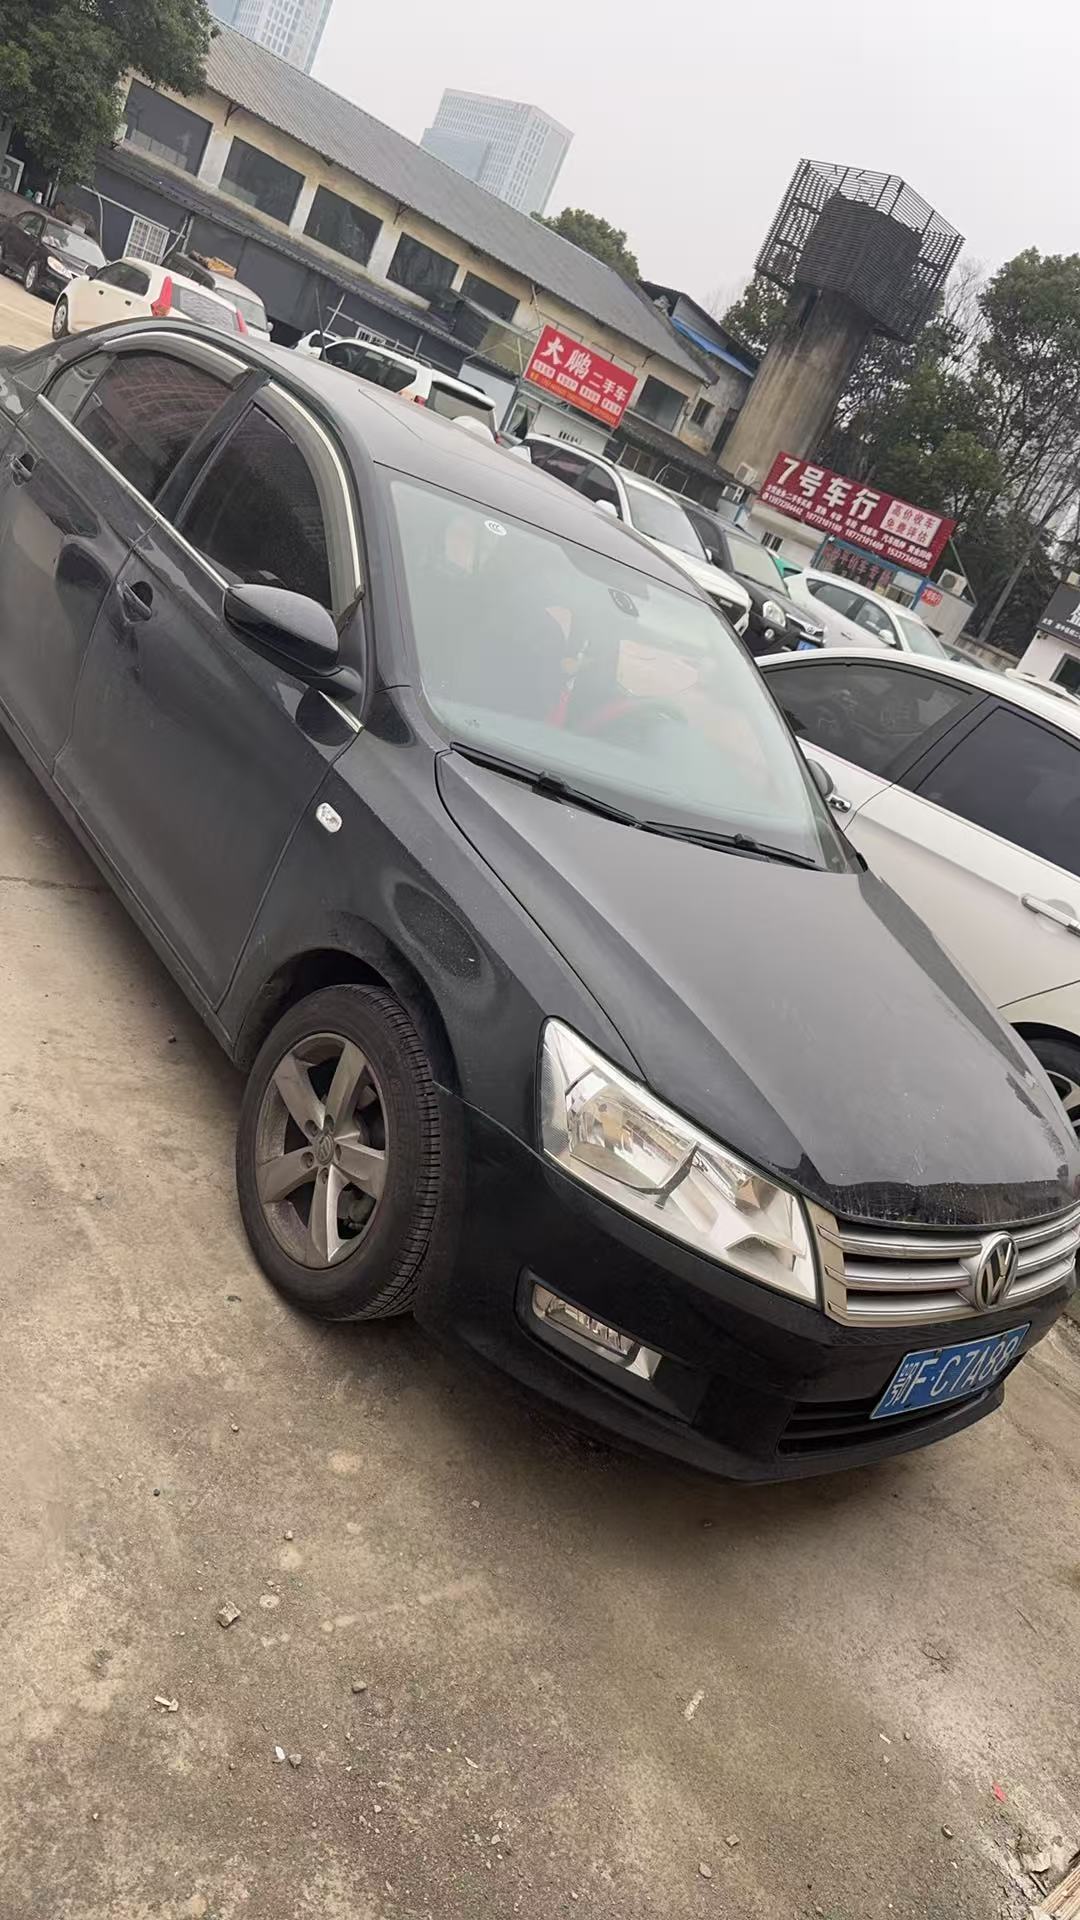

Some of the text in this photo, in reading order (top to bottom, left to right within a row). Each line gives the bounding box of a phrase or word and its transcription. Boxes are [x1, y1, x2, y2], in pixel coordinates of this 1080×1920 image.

[776, 457, 881, 521] 7号车行
[891, 503, 935, 529] 高价收车
[885, 518, 928, 543] 免费评估
